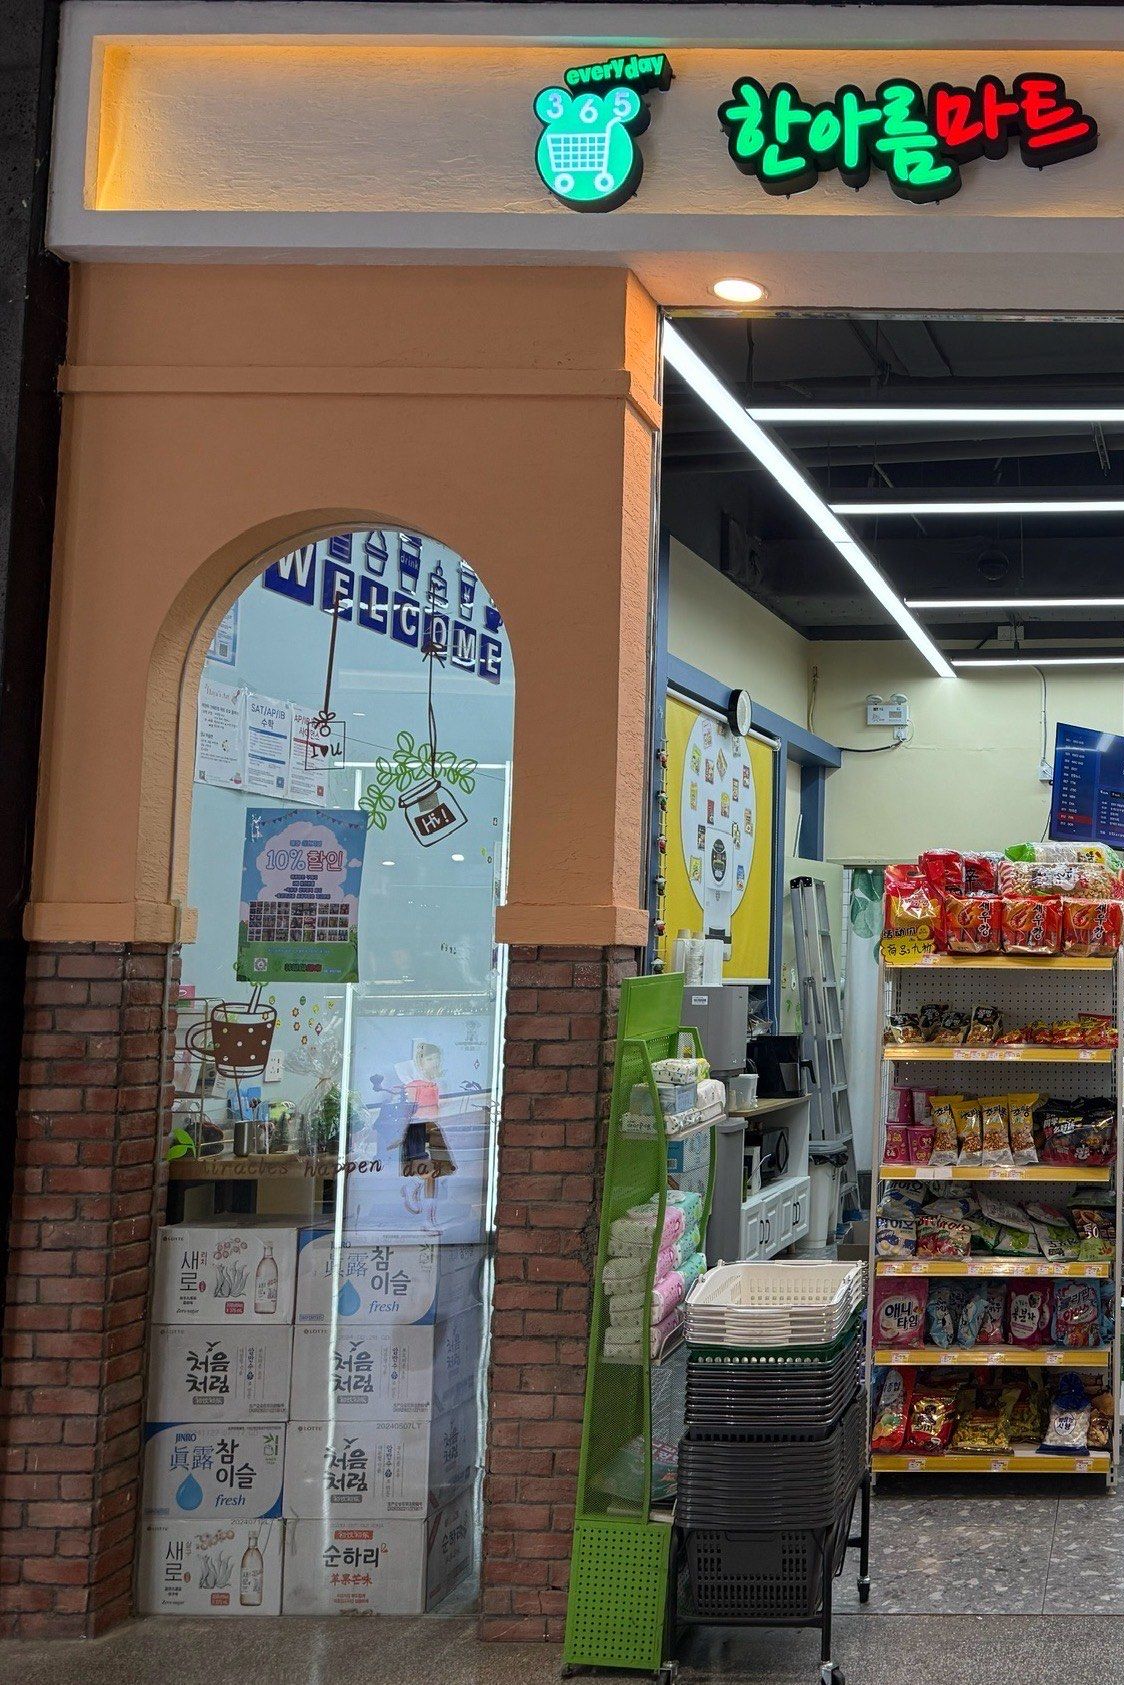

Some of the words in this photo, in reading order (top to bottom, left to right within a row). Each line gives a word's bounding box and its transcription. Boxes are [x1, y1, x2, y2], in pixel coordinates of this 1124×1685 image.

[566, 56, 664, 85] everyday
[251, 703, 286, 720] SAT/AP/IB
[421, 808, 449, 835] Hi!
[266, 849, 306, 871] 10%
[307, 850, 344, 872] 할인
[369, 1300, 400, 1315] fresh
[884, 1301, 912, 1319] 애니
[897, 1314, 918, 1330] 타임
[186, 1350, 231, 1374] 처음
[334, 1350, 374, 1373] 처음
[185, 1373, 230, 1394] 처럼
[333, 1373, 374, 1393] 처럼
[176, 1433, 197, 1444] JINRO
[215, 1438, 240, 1465] 참
[324, 1447, 368, 1471] 처음
[215, 1462, 257, 1490] 이슬
[327, 1471, 368, 1492] 처럼
[214, 1494, 246, 1508] fresh
[323, 1544, 379, 1568] 순하리
